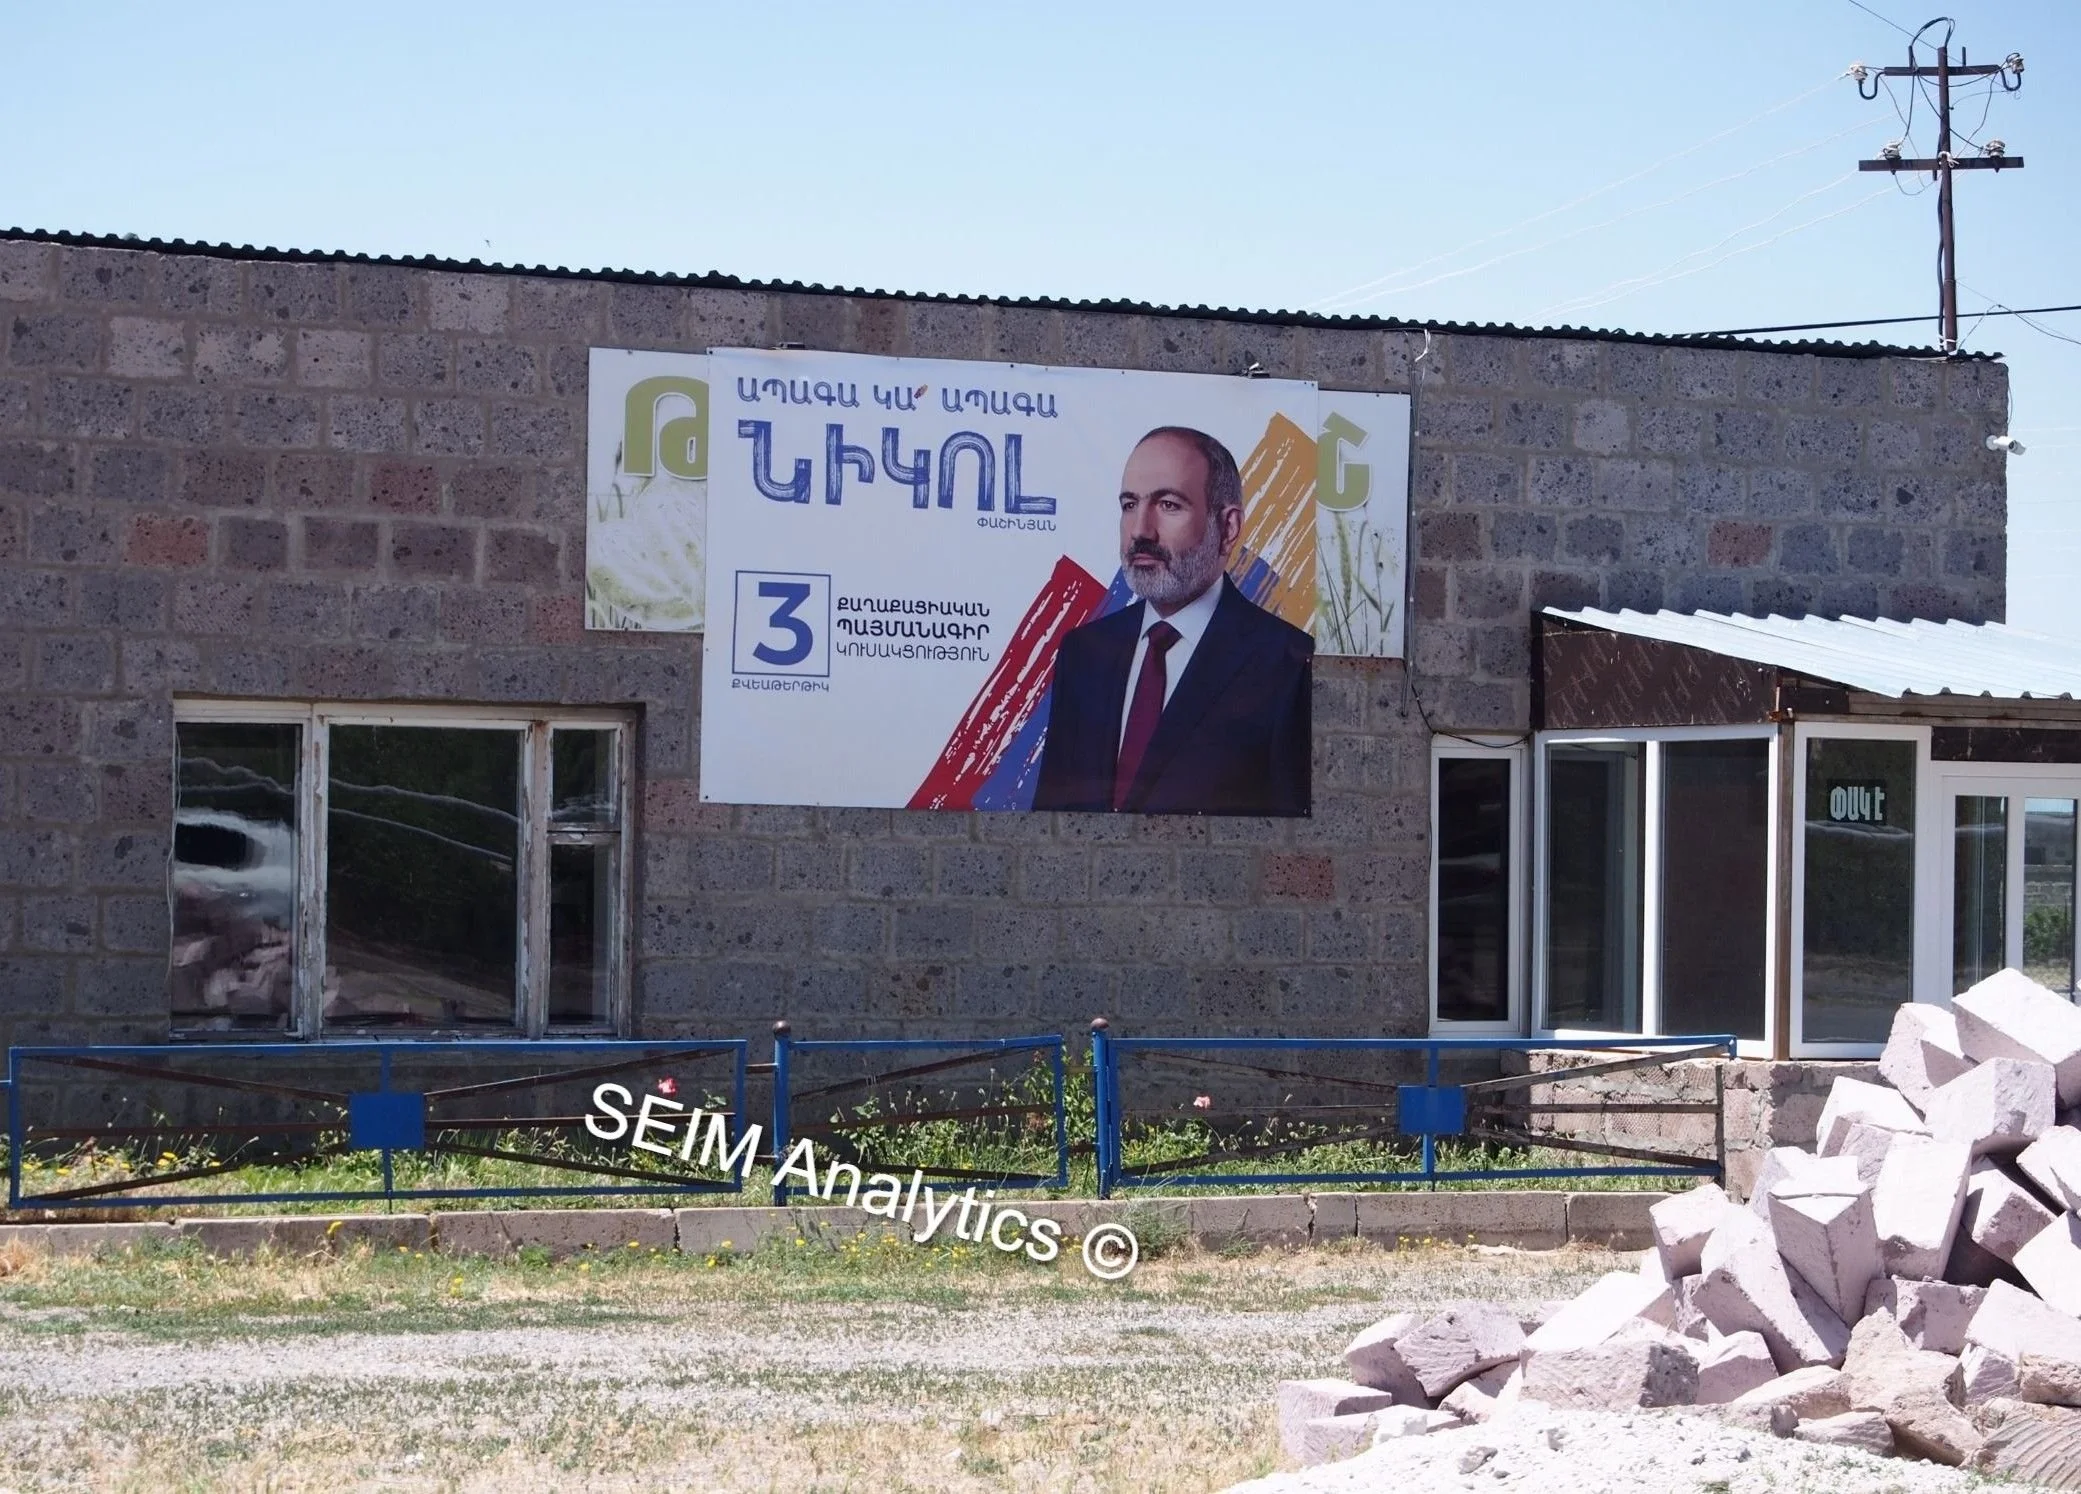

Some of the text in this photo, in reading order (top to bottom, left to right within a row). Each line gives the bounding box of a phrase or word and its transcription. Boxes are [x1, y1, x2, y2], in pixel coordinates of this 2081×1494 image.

[737, 376, 859, 408] ԱՊԱԳԱ
[941, 387, 1058, 418] ԱՊԱԳԱ
[738, 419, 1056, 515] ՆԻԿՈԼ
[977, 517, 1057, 532] ՓԱՇԻՆՅԱՆ
[837, 597, 990, 617] ՔԱՂԱՔԱՑԻԱԿԱՆ
[753, 581, 813, 665] 3
[836, 619, 990, 640] ՊԱՅՄԱՆԱԳԻՐ
[836, 642, 990, 662] ԿՈՒՍԱԿՑՈՒԹՅՈՒՆ
[732, 679, 829, 692] ՔՎԵԱԹԵՐԹԻԿ
